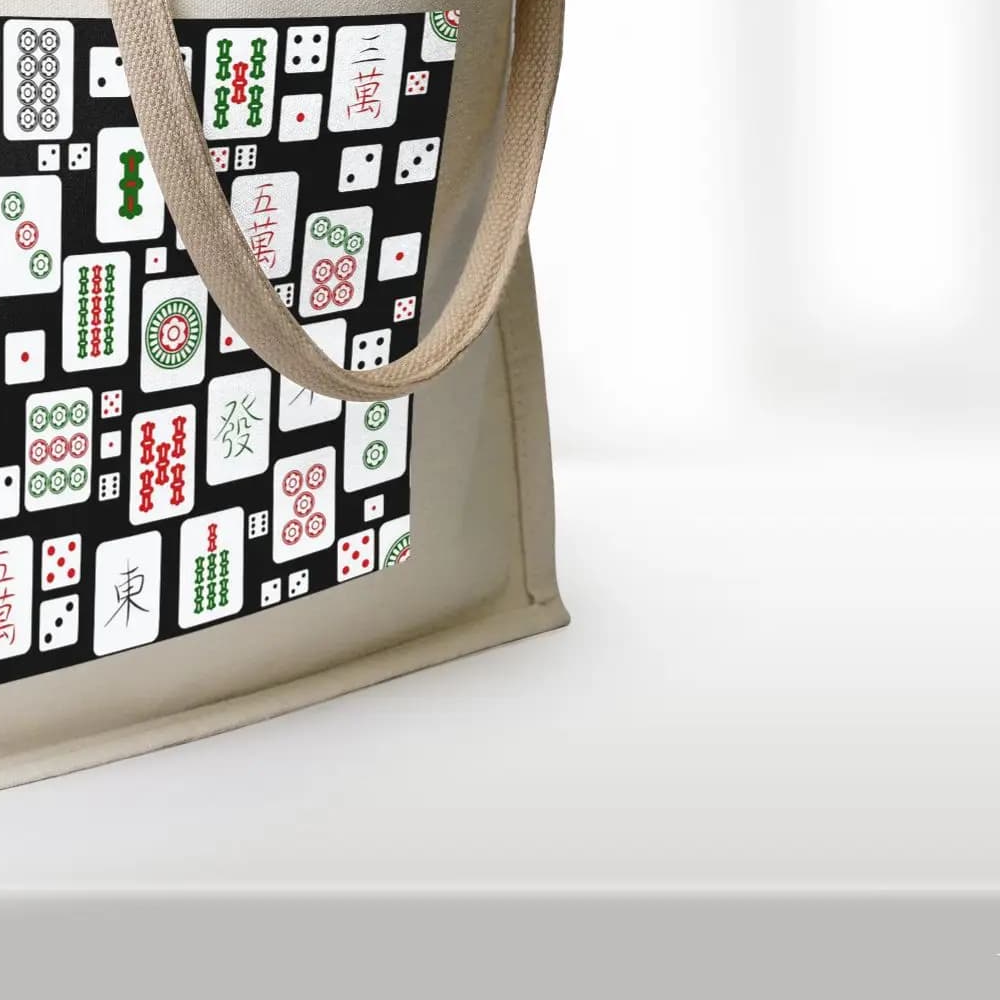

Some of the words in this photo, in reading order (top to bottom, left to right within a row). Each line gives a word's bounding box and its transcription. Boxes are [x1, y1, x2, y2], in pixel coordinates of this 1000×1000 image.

[347, 34, 387, 120] 三萬
[213, 394, 264, 459] 發
[104, 560, 150, 629] 東
